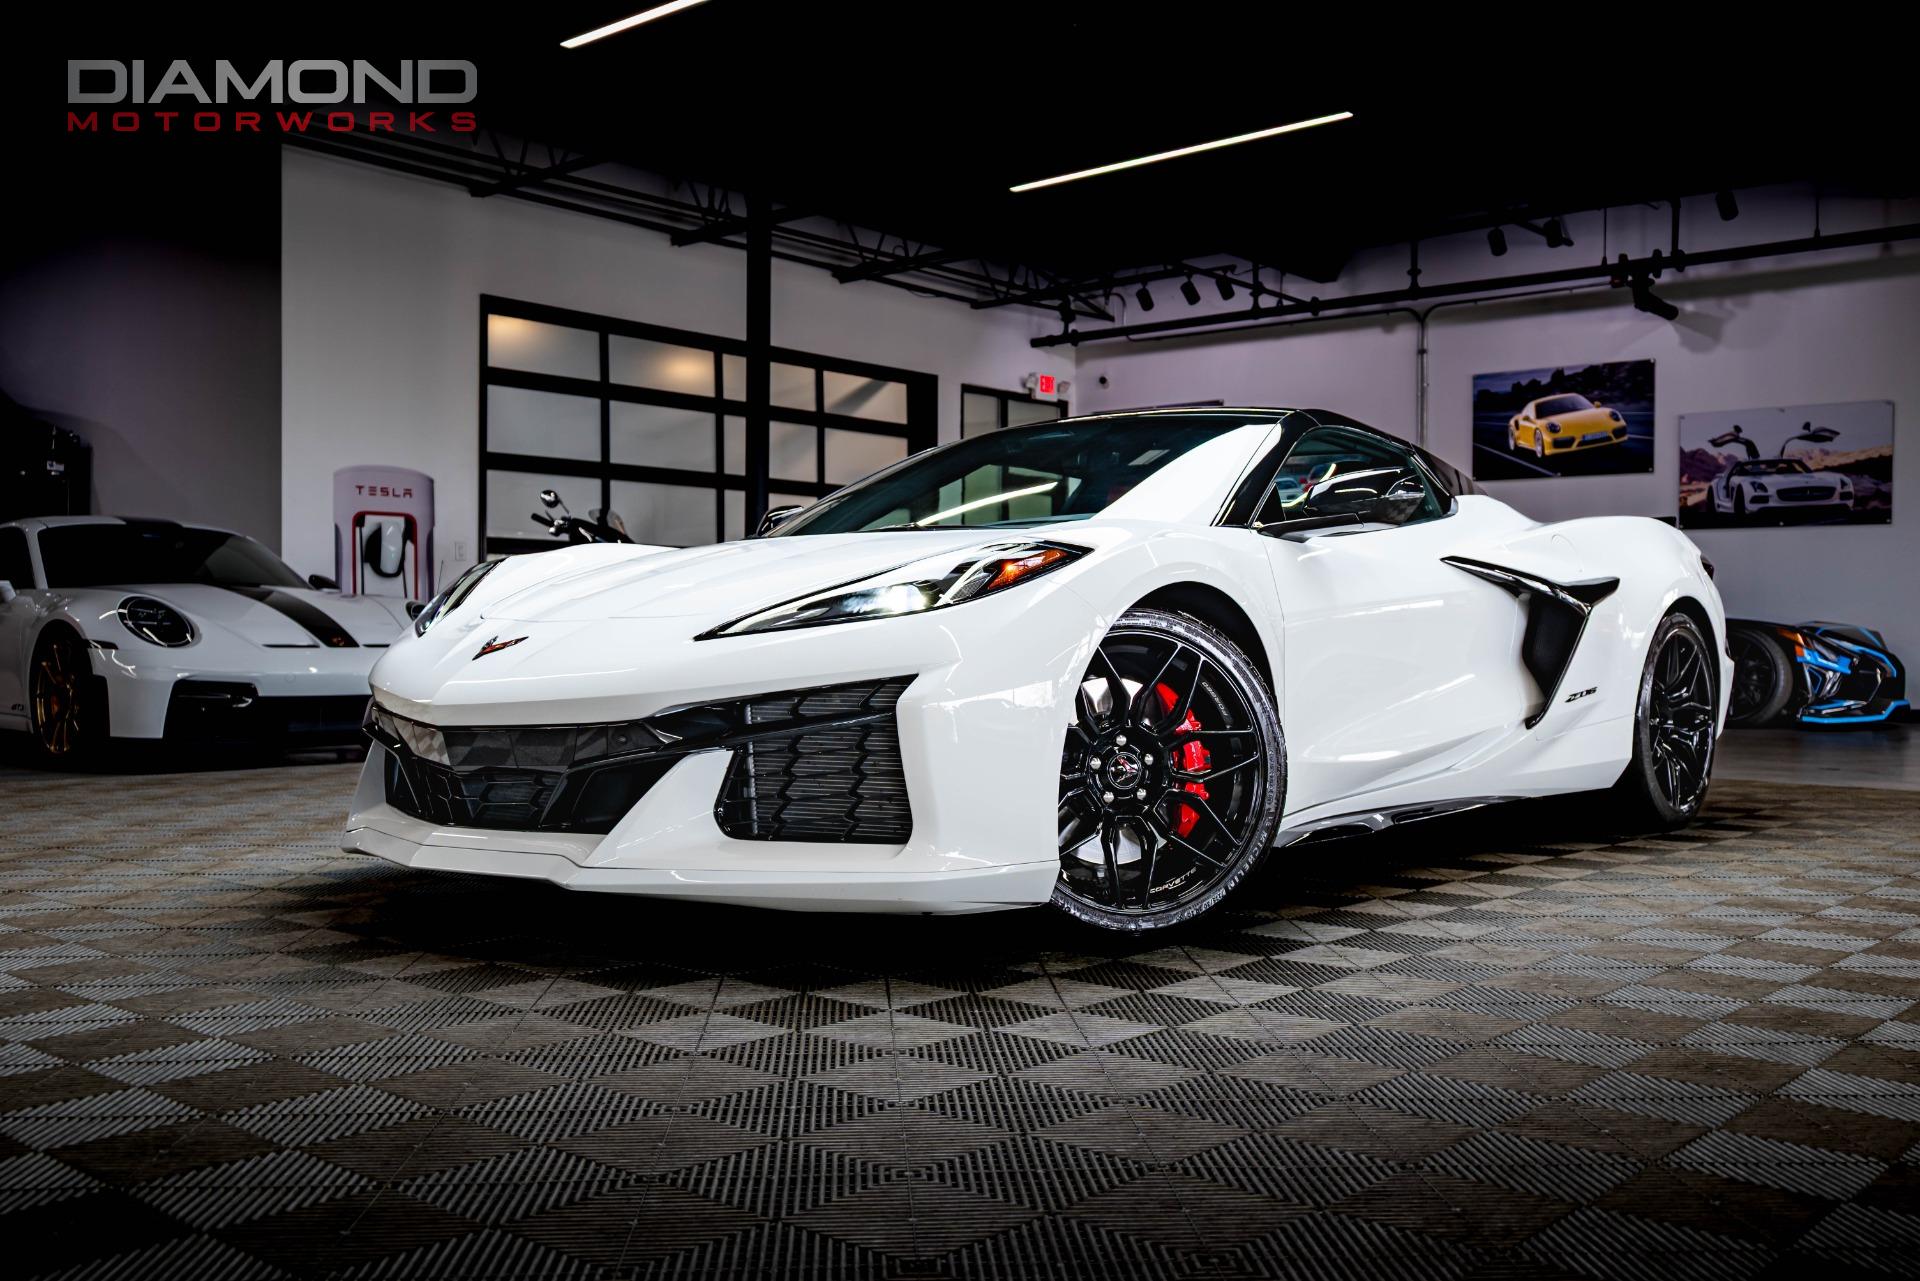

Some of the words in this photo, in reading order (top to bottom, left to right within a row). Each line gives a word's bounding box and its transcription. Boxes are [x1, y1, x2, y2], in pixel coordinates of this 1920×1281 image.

[355, 484, 413, 498] TESLA
[1227, 830, 1268, 891] MICHELIN
[1150, 866, 1197, 894] CORVETTE
